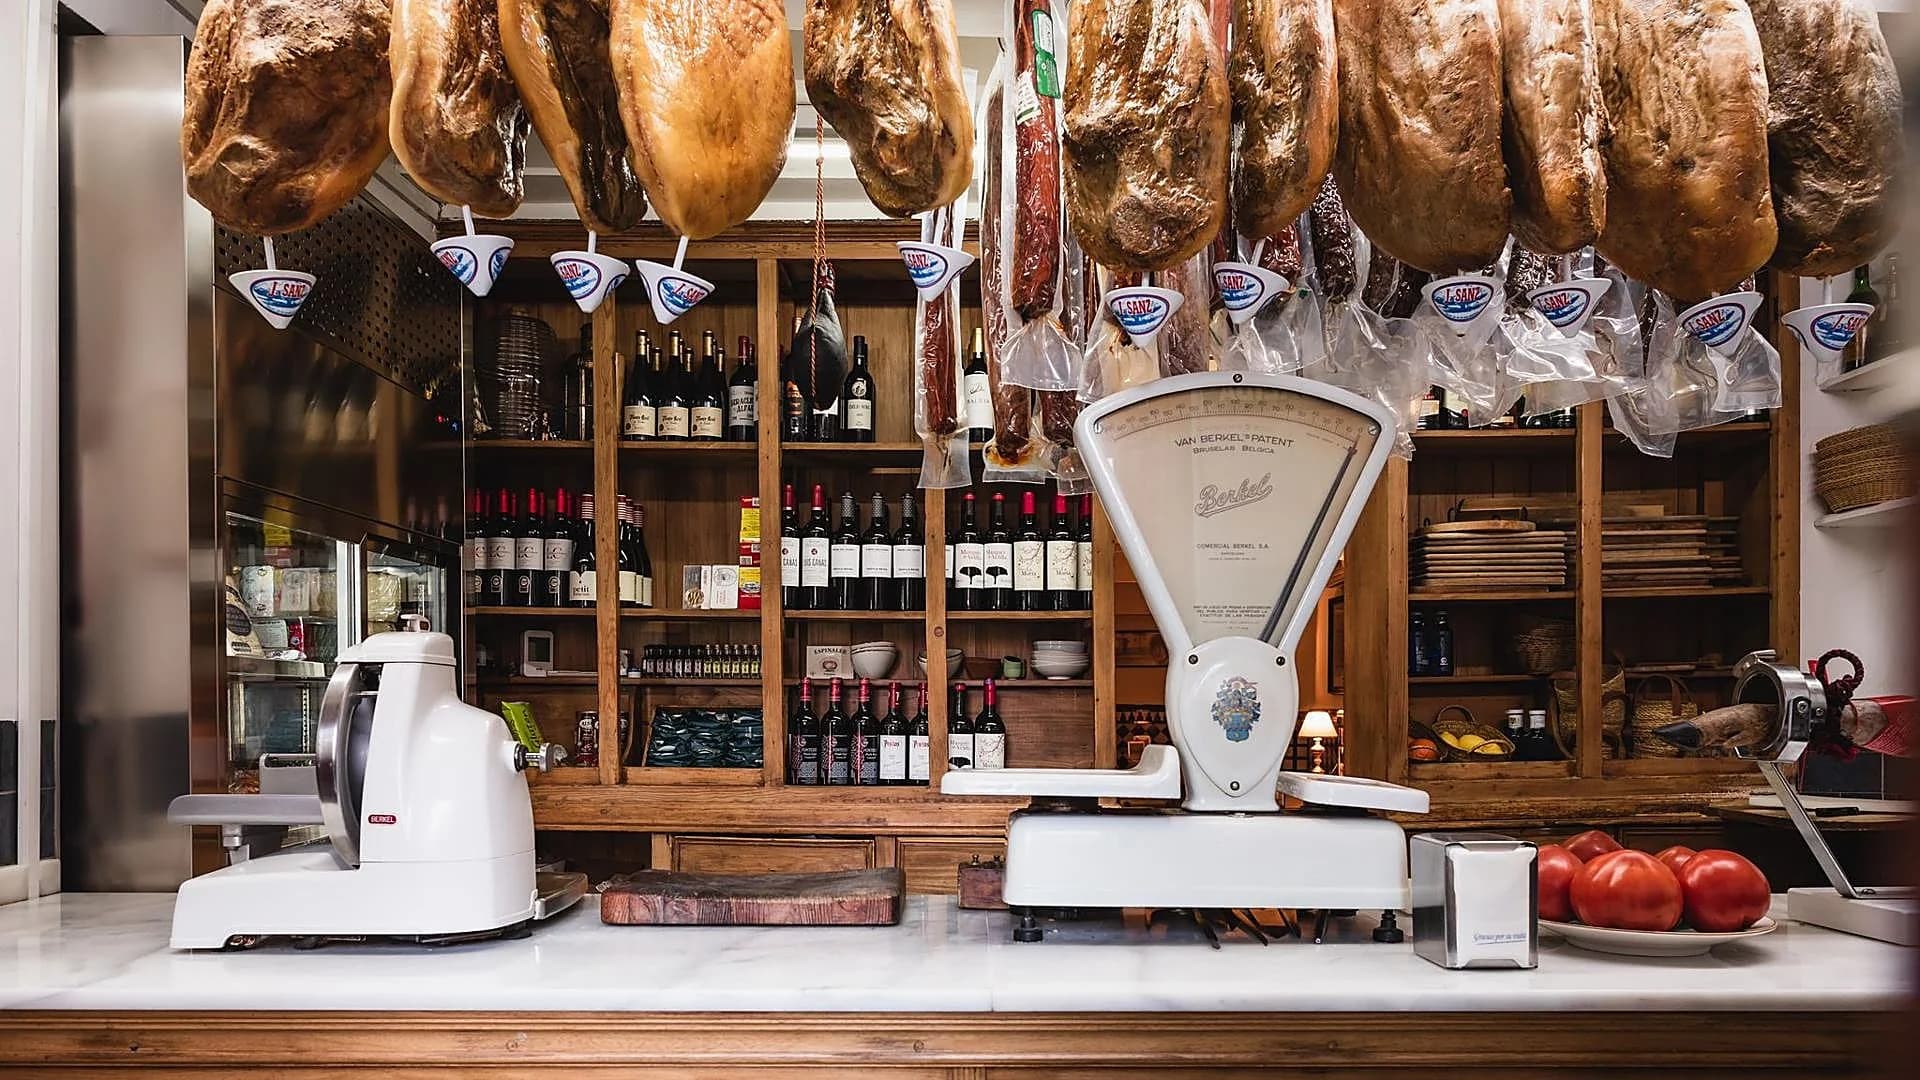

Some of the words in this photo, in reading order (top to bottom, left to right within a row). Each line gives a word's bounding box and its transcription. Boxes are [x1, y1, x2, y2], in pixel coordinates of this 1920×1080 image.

[907, 253, 929, 268] SANZ
[559, 263, 582, 279] SANZ
[283, 283, 306, 298] SANZ
[1223, 275, 1245, 290] SANZ
[1455, 286, 1480, 302] SANZ
[1545, 292, 1569, 309] SANZ
[1127, 299, 1153, 315] SANZ
[1697, 310, 1725, 330] SANZ
[1174, 437, 1197, 447] VAN
[1251, 434, 1295, 448] PATENT
[1193, 472, 1273, 519] Berkel
[370, 815, 395, 823] BERKEL
